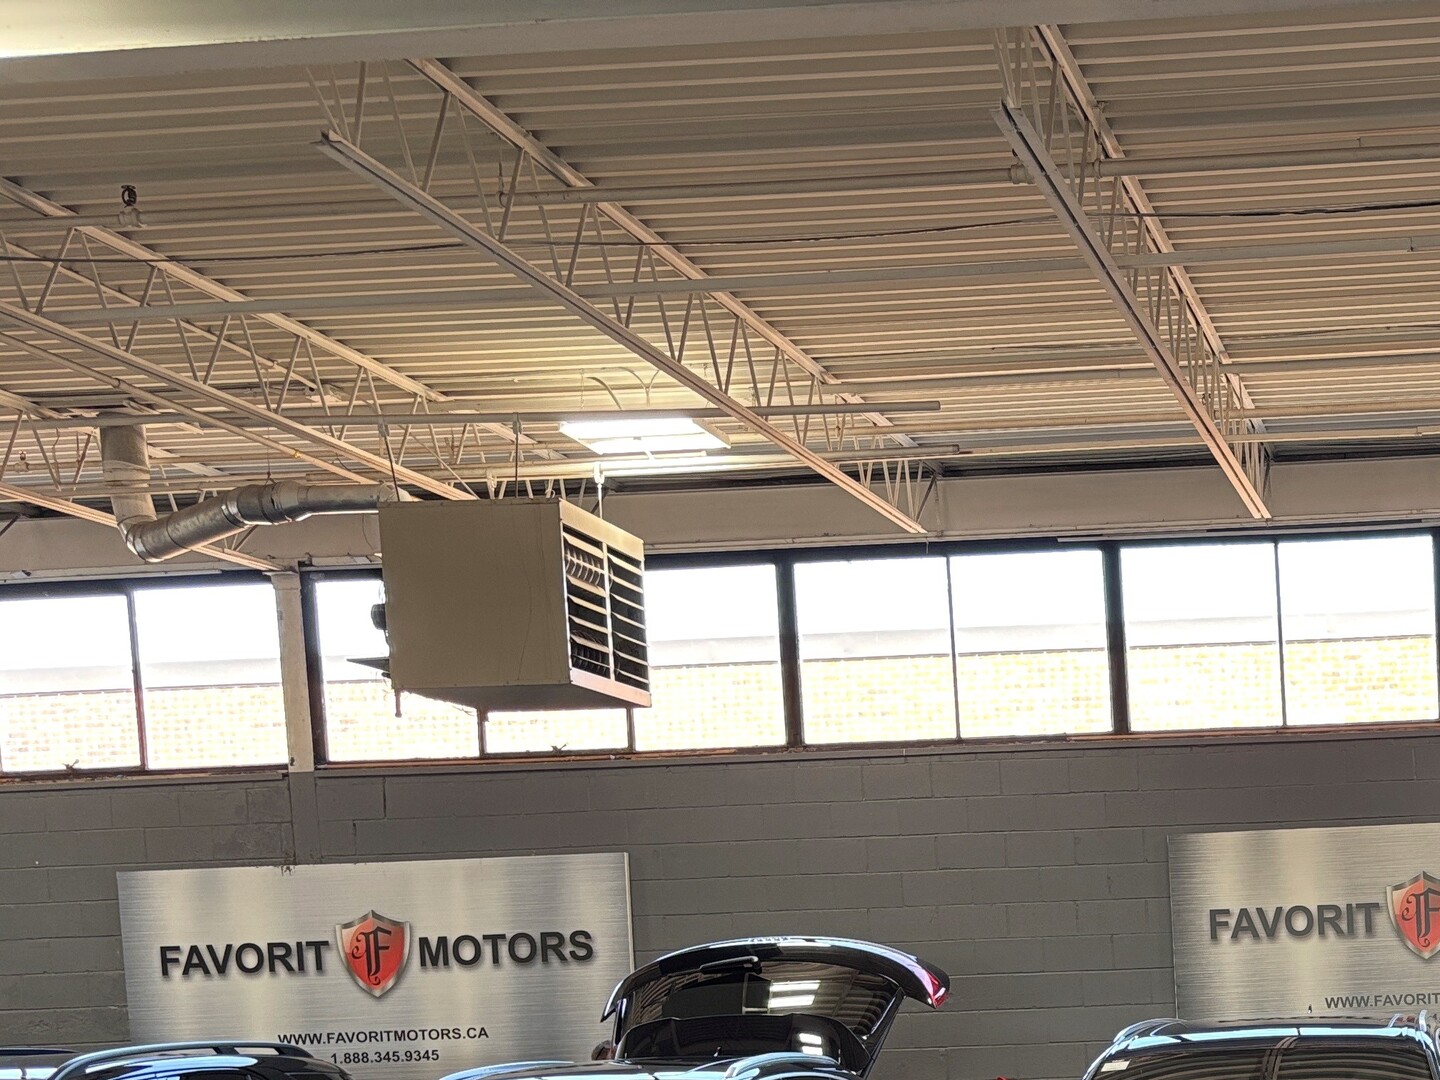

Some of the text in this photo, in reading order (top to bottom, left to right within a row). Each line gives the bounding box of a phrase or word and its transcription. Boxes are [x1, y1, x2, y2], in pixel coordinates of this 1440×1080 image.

[1208, 902, 1380, 941] FAVORIT
[159, 940, 330, 977] FAVORIT
[418, 930, 594, 968] MOTORS
[277, 1026, 489, 1046] WWW.FAVORITMOTORS.CA
[330, 1049, 440, 1065] 1.888.345.9345
